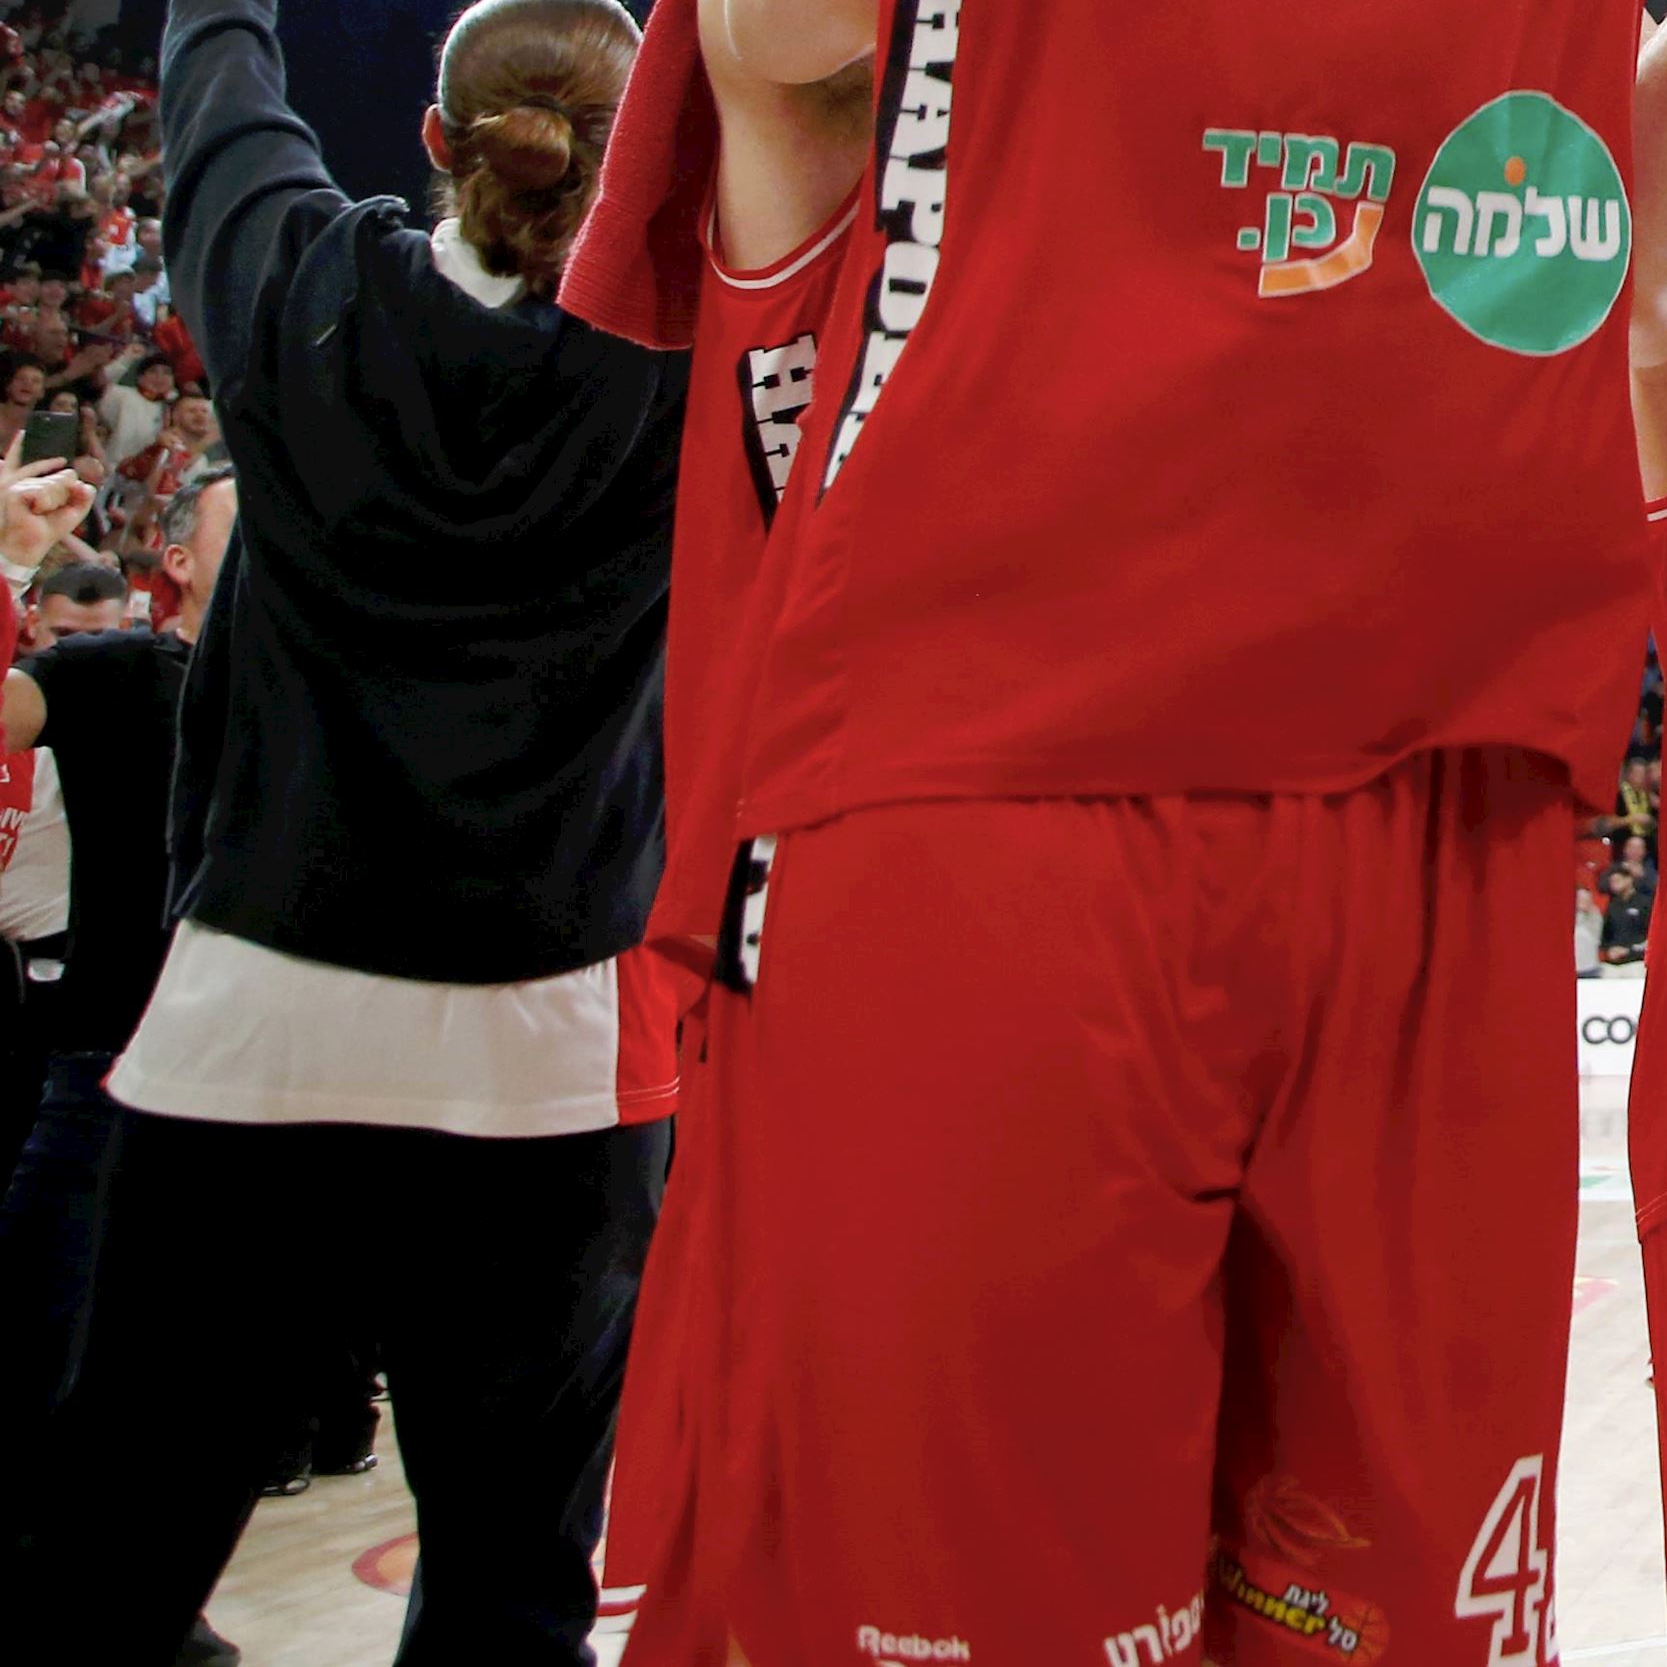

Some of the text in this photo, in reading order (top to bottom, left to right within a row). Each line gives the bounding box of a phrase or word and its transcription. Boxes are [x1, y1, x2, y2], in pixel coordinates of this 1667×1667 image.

[1202, 128, 1397, 202] תמיד
[1421, 186, 1621, 262] שלמה
[1455, 1453, 1557, 1667] 4
[857, 1623, 971, 1663] Reebok
